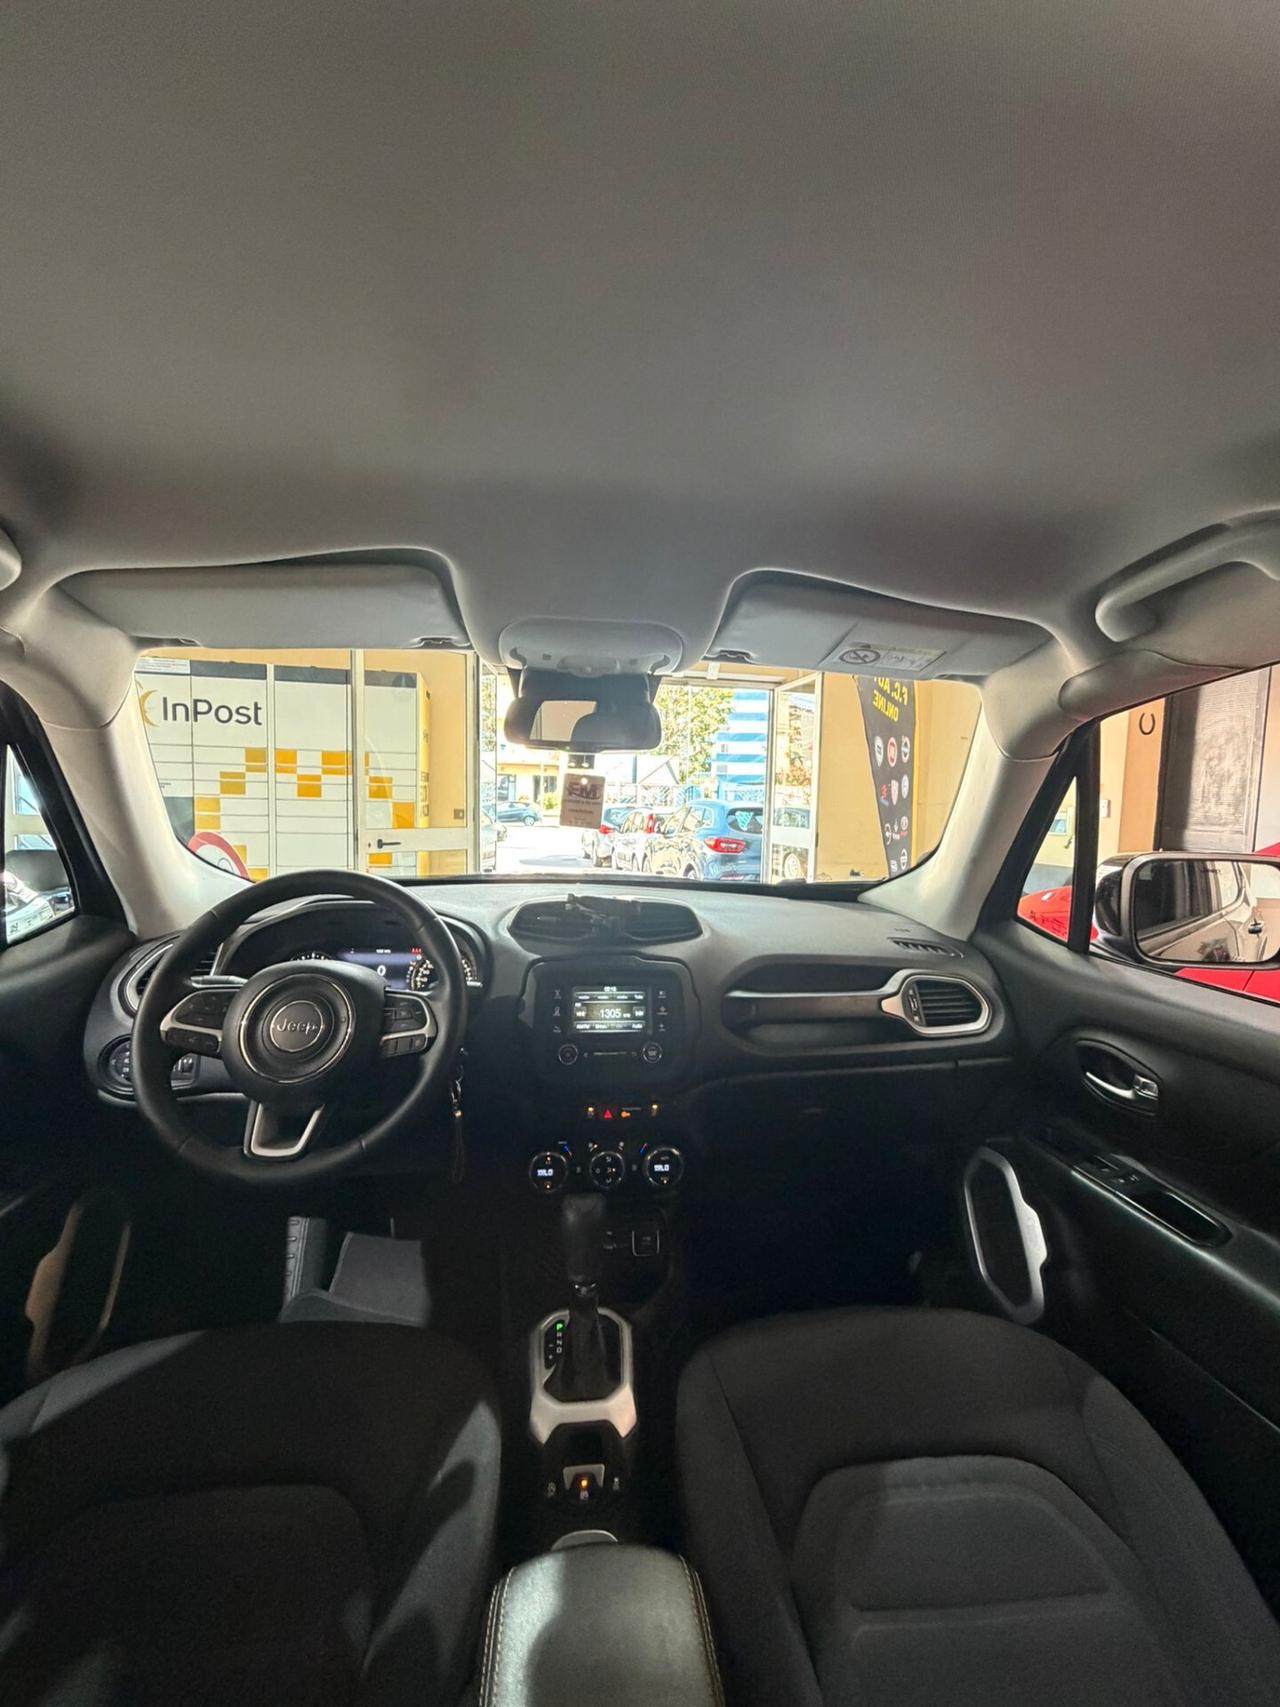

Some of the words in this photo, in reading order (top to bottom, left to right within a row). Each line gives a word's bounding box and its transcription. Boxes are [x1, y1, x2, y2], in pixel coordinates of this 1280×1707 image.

[162, 696, 263, 726] InPost
[600, 1008, 622, 1018] 1305
[276, 1018, 317, 1035] Jeep
